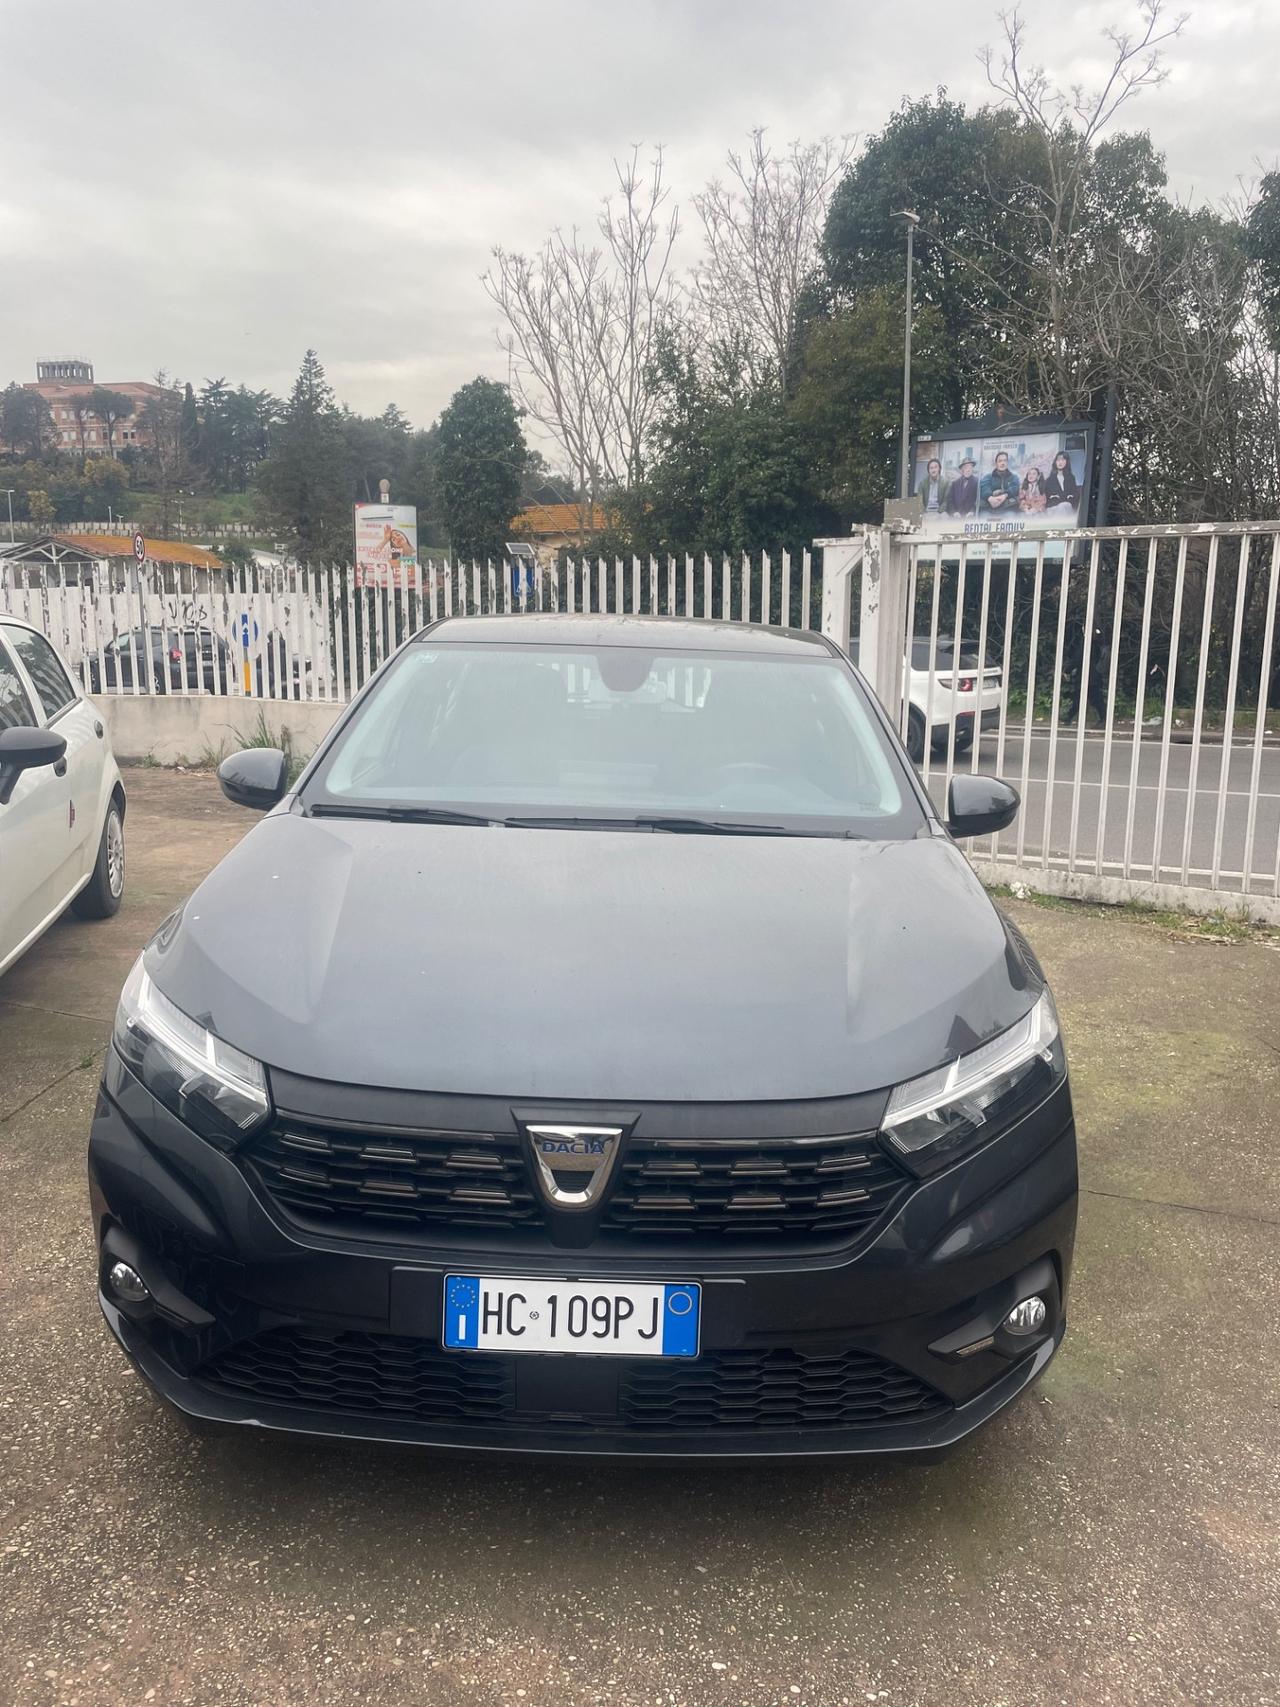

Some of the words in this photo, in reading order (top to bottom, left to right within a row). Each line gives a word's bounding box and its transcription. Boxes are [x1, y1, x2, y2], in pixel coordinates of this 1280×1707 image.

[995, 521, 1025, 533] FAMILY
[136, 539, 144, 556] 50
[542, 1142, 605, 1154] DACIA
[482, 1291, 527, 1336] HC
[547, 1295, 659, 1340] 109PJ
